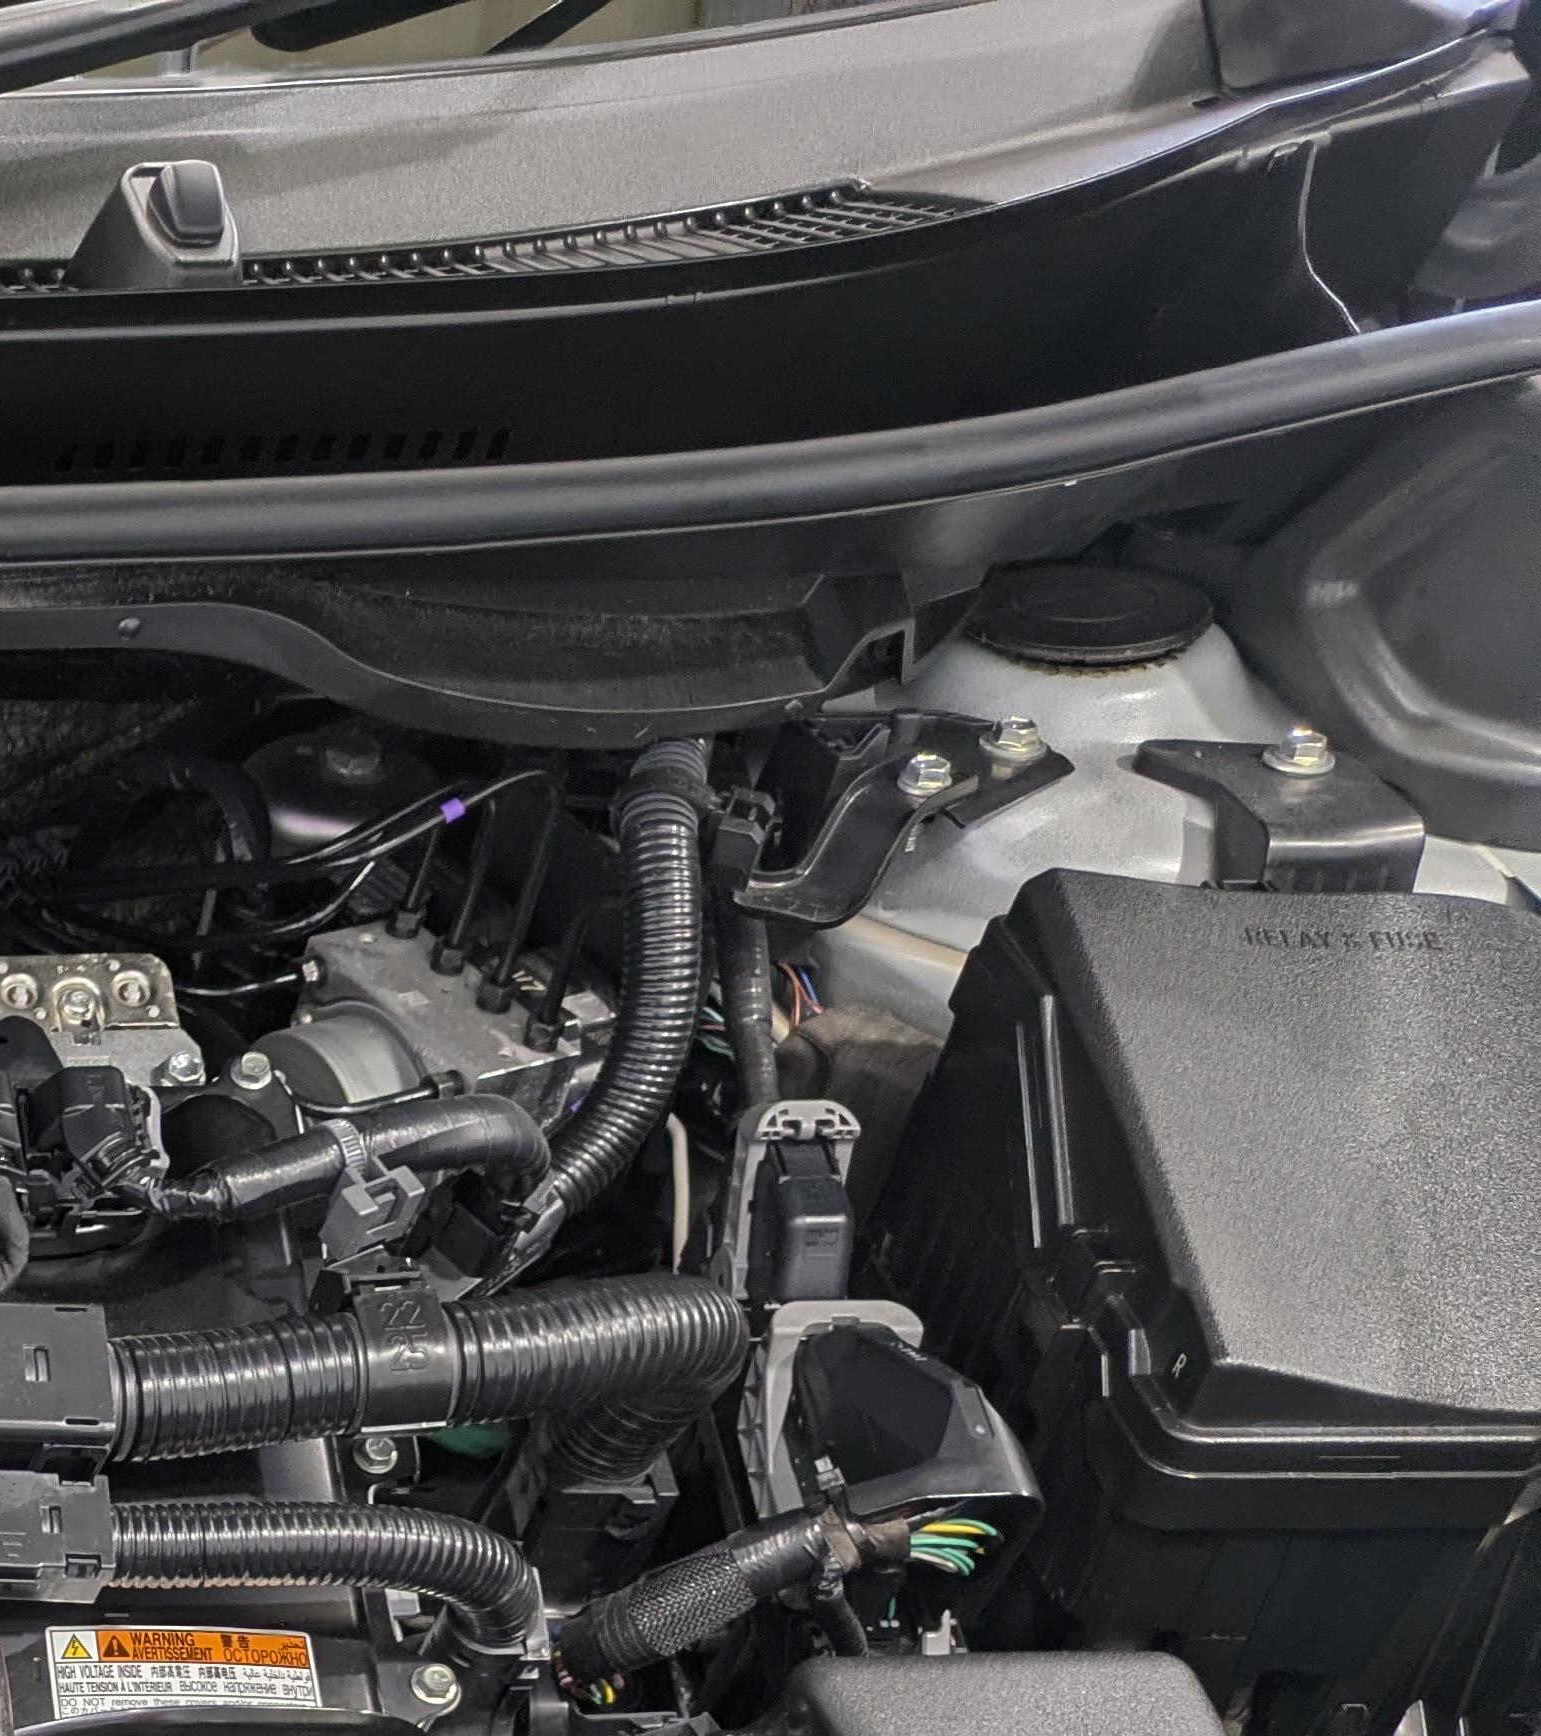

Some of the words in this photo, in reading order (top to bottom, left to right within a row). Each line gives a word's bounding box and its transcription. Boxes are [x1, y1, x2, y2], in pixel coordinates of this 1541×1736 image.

[129, 1632, 196, 1647] WARNING
[131, 1646, 213, 1661] AVERTISSEMENT
[223, 1647, 308, 1666] ОСТОРОЖНО
[57, 1665, 77, 1678] HIGH
[79, 1665, 115, 1678] VOLTAGE
[117, 1665, 143, 1678] INSIDE
[59, 1681, 85, 1693] HAUTE
[86, 1681, 119, 1693] TENSION
[61, 1698, 78, 1707] DO
[83, 1697, 105, 1707] NOT
